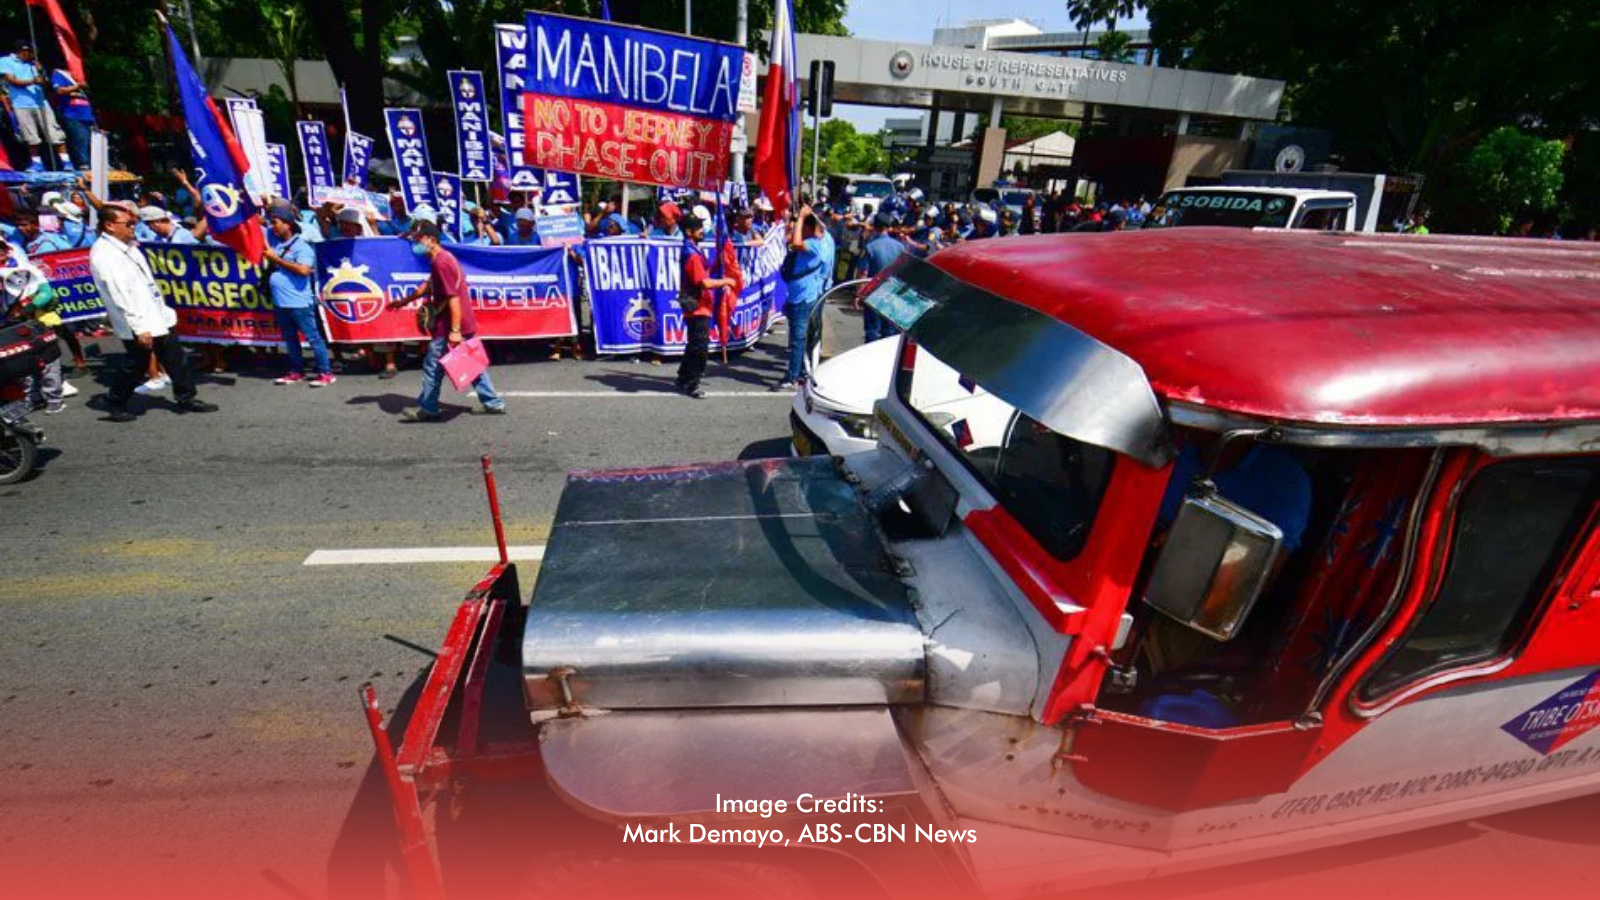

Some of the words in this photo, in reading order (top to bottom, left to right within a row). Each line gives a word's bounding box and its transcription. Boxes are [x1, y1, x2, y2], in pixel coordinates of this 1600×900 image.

[536, 25, 734, 115] MANIBELA
[921, 52, 970, 70] HOUSE
[975, 58, 994, 72] OF
[1000, 59, 1127, 82] REPRESENTATIVES
[534, 98, 570, 133] NO
[574, 102, 607, 134] TO
[613, 108, 713, 149] JEEPNEY
[304, 124, 326, 186] MANIBE
[458, 102, 486, 179] MANIBELA
[536, 131, 715, 188] PHASE-OUT
[1181, 195, 1263, 211] SOBIDA
[145, 248, 188, 277] NO
[192, 250, 229, 279] TO
[590, 244, 650, 291] IBALIK
[656, 245, 682, 291] AN
[73, 282, 96, 295] TO
[155, 278, 273, 309] PHASEO
[388, 284, 567, 310] MIBELA
[1520, 704, 1569, 731] TRIBE
